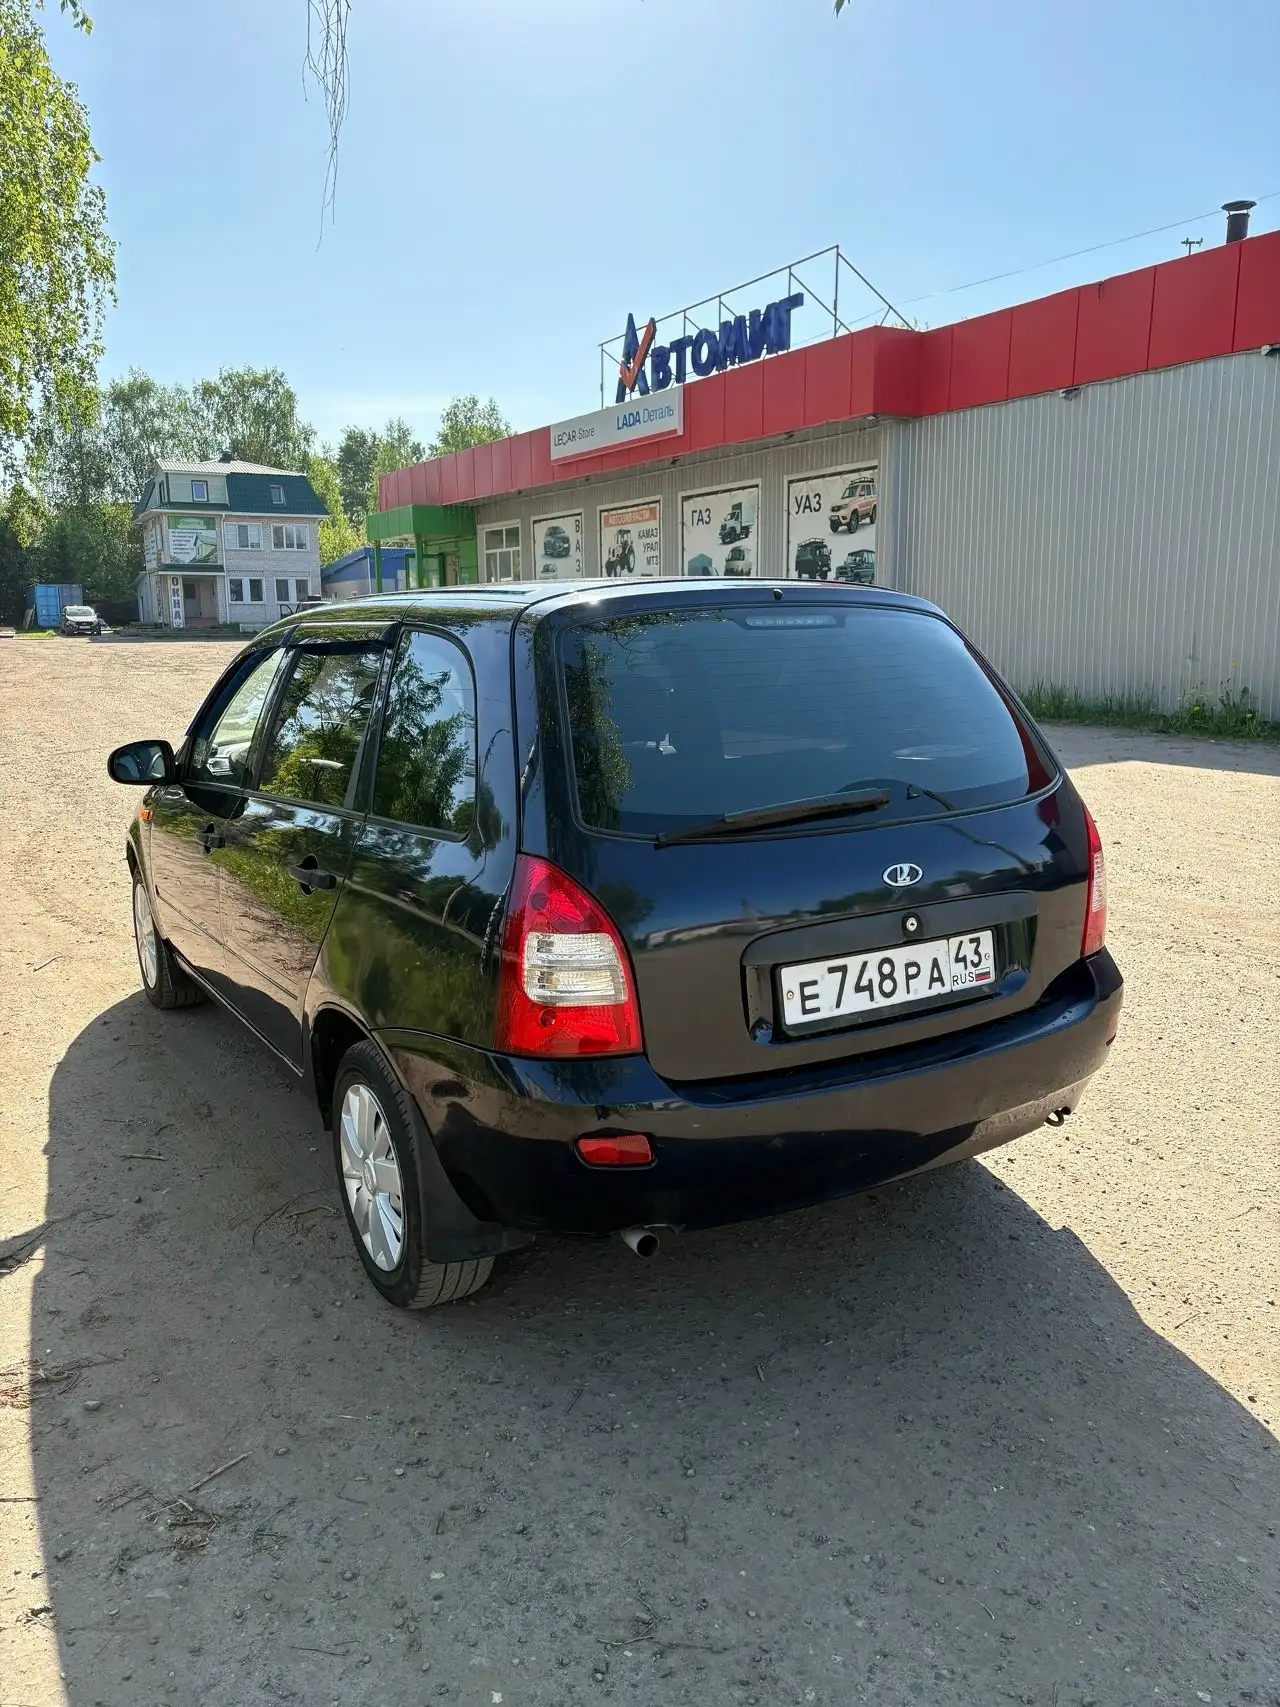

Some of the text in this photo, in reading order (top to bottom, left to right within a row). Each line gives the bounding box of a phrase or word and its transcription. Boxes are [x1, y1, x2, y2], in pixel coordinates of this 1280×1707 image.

[615, 292, 804, 403] АВТОМИГ
[616, 410, 641, 431] LADA
[553, 427, 595, 447] LECAR Store
[795, 492, 822, 515] УАЗ
[691, 507, 712, 527] ГАЗ
[637, 527, 659, 540] КАМАЗ
[642, 541, 659, 553] УРАЛ
[646, 555, 659, 566] МТЗ
[799, 936, 982, 1016] Е748РА 43
[952, 971, 975, 987] RUS
